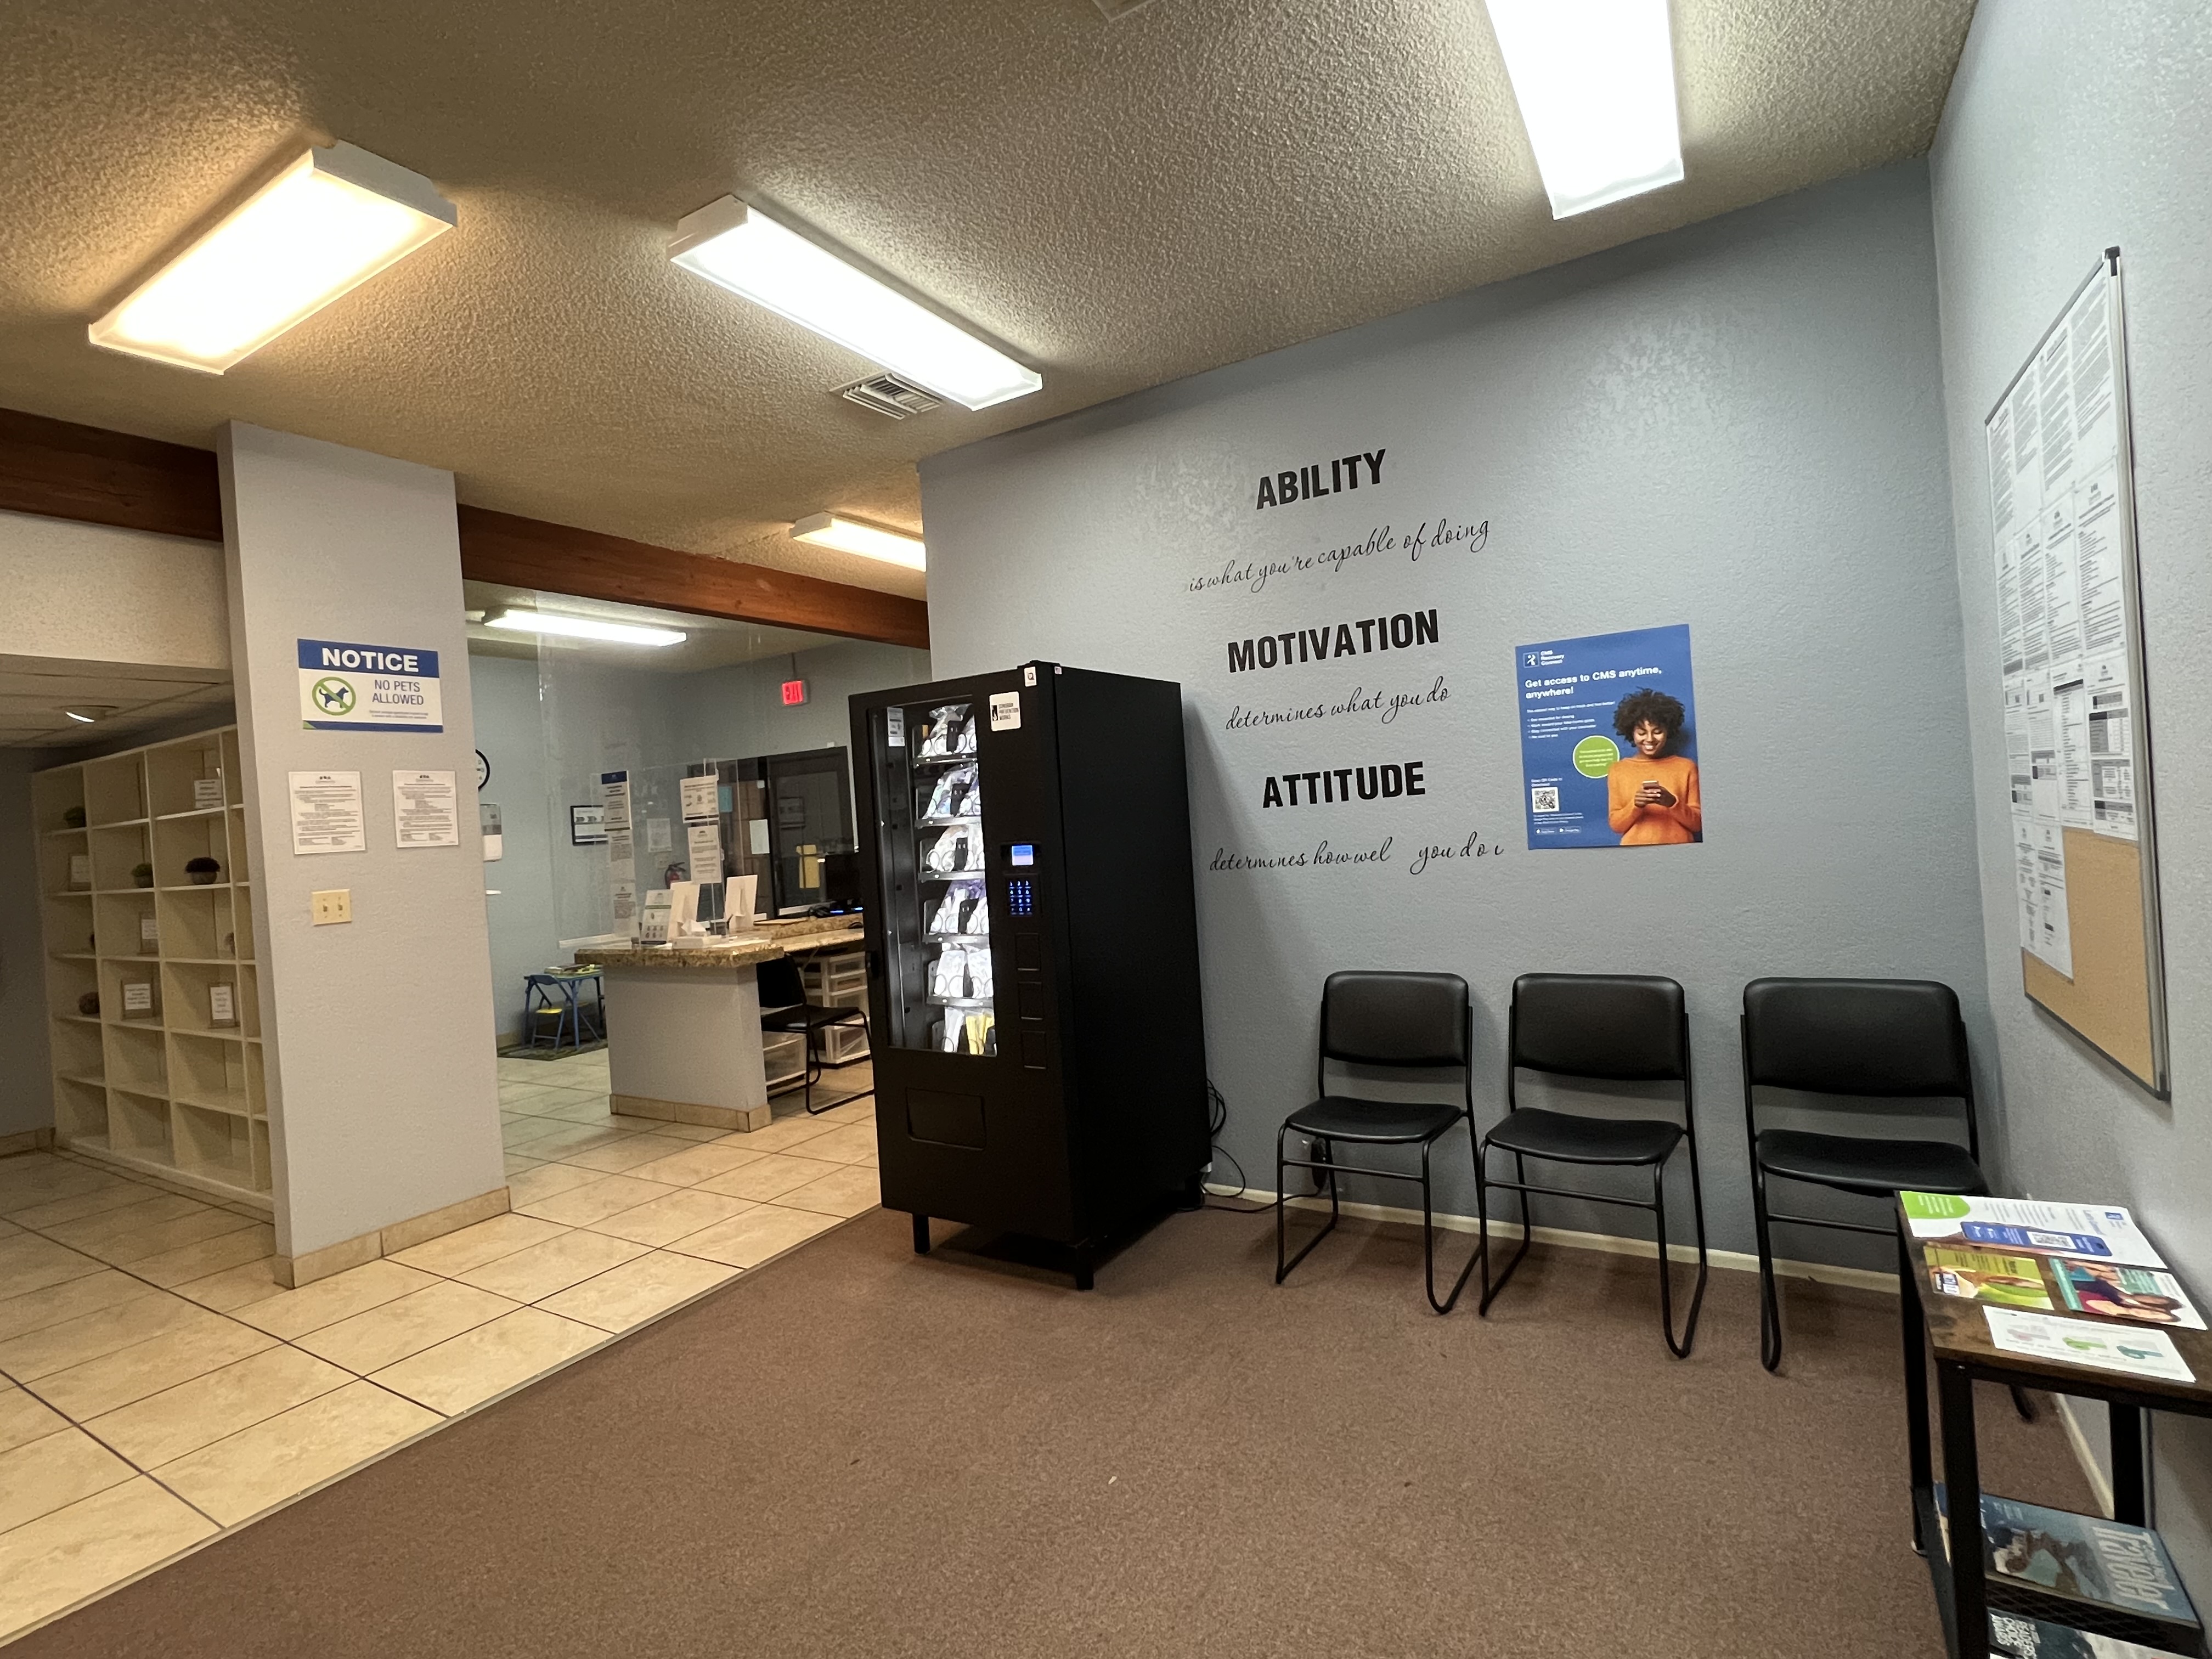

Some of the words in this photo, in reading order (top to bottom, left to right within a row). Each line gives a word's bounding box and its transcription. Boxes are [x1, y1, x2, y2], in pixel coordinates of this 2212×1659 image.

[1256, 448, 1386, 510] ABILITY
[1189, 578, 1205, 592] is
[1206, 560, 1254, 588] what
[1250, 556, 1314, 594] you're
[1318, 525, 1397, 572] capable
[1403, 522, 1427, 562] of
[1431, 518, 1491, 553] doing
[1228, 608, 1440, 674] MOTIVATION
[322, 647, 419, 673] NOTICE
[1525, 679, 1542, 689] Get
[1544, 676, 1578, 687] access
[1579, 674, 1590, 682] to
[1592, 670, 1616, 681] CMS
[1618, 666, 1662, 678] anytime,
[371, 693, 424, 706] ALLOWED
[374, 679, 391, 691] NO
[393, 680, 421, 692] PETS
[1226, 703, 1327, 730] determines
[1330, 686, 1386, 716] what
[1381, 692, 1425, 724] you
[1426, 675, 1451, 703] do
[1525, 686, 1574, 700] anywhere!
[1262, 761, 1426, 809] ATTITUDE
[1209, 848, 1308, 871] determines
[1313, 840, 1352, 865] how
[1409, 845, 1455, 876] you
